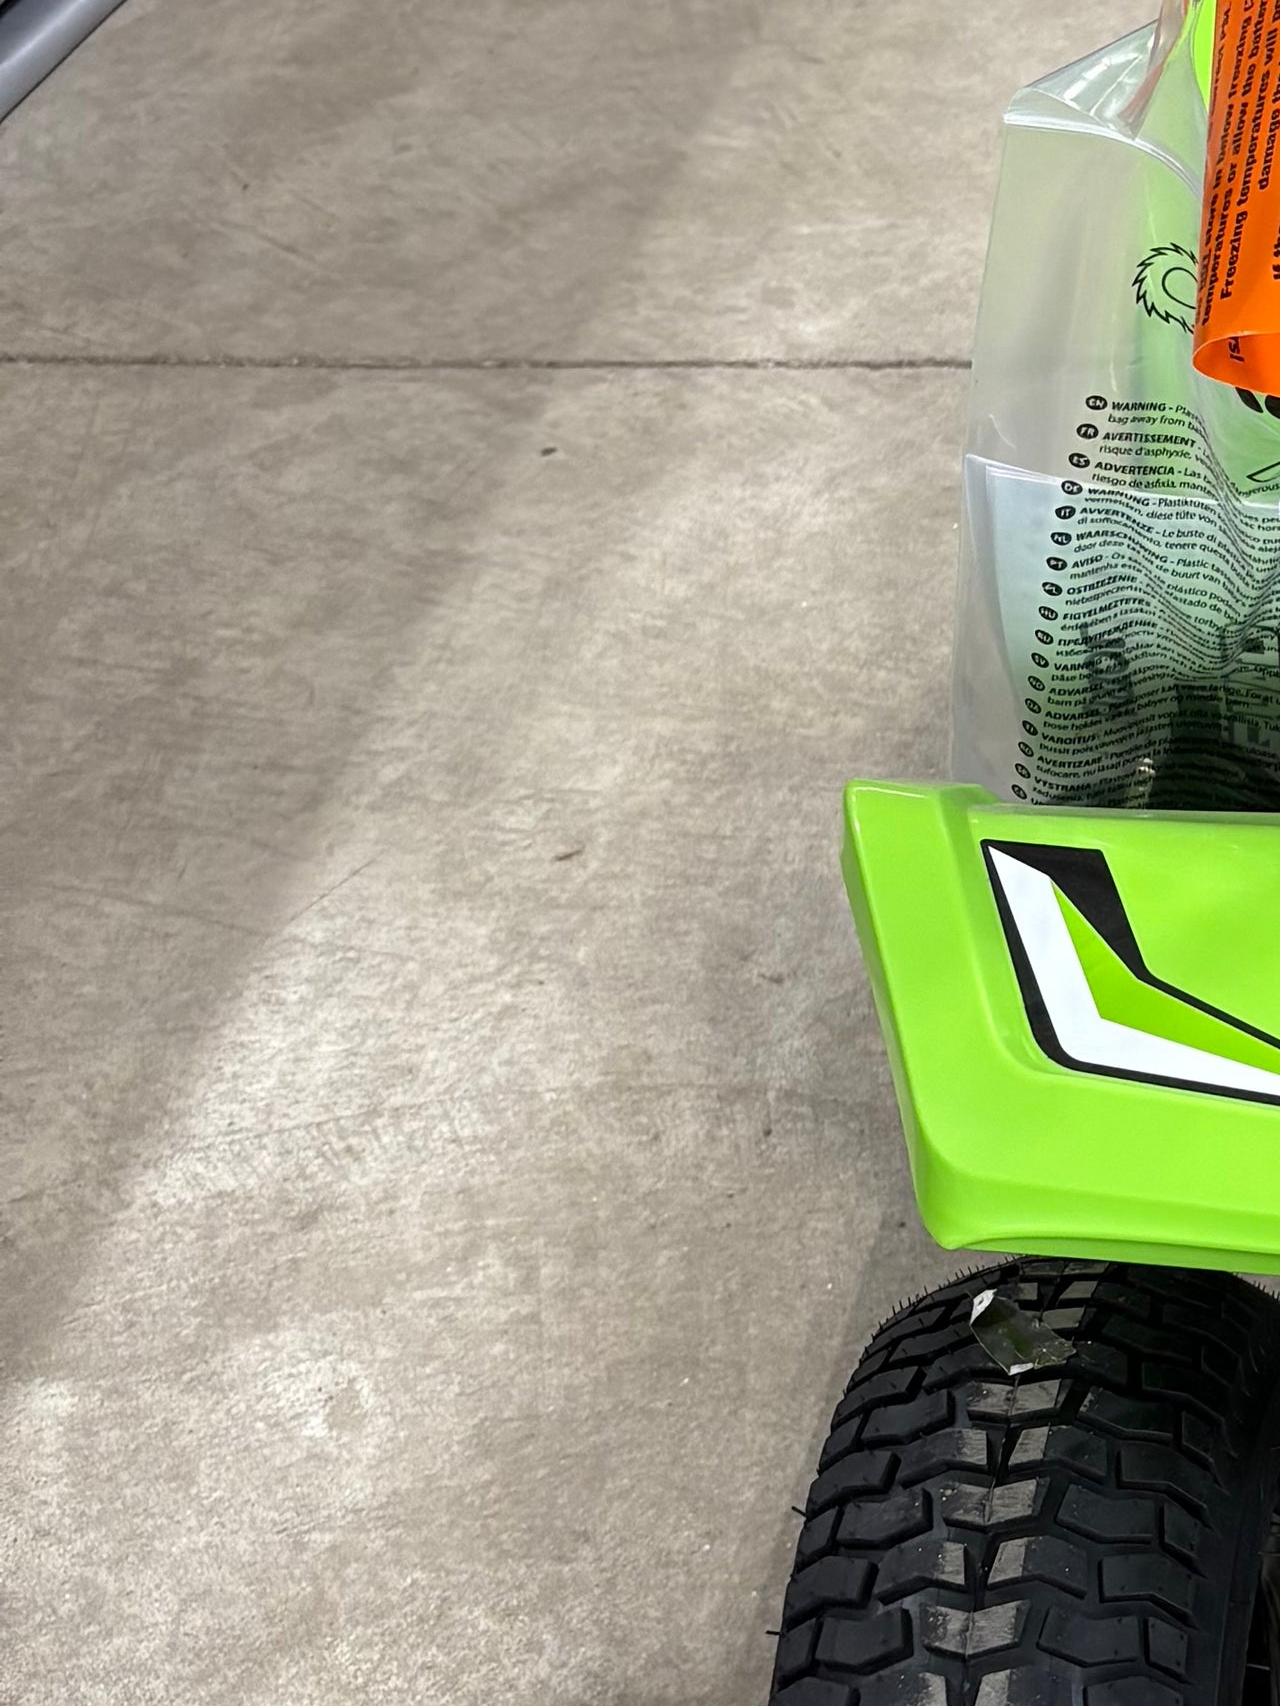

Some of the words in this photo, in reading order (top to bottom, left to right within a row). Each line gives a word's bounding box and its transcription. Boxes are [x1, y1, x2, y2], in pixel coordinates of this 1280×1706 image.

[1216, 103, 1235, 166] below
[1228, 15, 1252, 100] freezing
[1258, 108, 1280, 190] damage
[1220, 210, 1249, 301] Freezing
[1236, 69, 1270, 207] temperatures
[1263, 26, 1279, 66] will
[1202, 187, 1233, 327] temperatures
[1227, 162, 1237, 183] or
[1232, 101, 1249, 156] allow
[1241, 62, 1257, 98] the
[1111, 401, 1167, 413] WARNING
[1160, 415, 1186, 428] from
[1102, 431, 1197, 449] AVERTISSEMENT
[1099, 444, 1133, 457] risque
[1094, 461, 1175, 476] ADVERTENCIA
[1091, 472, 1127, 488] riesgo
[1088, 488, 1151, 507] WARNUNG
[1071, 554, 1104, 569] AVISO
